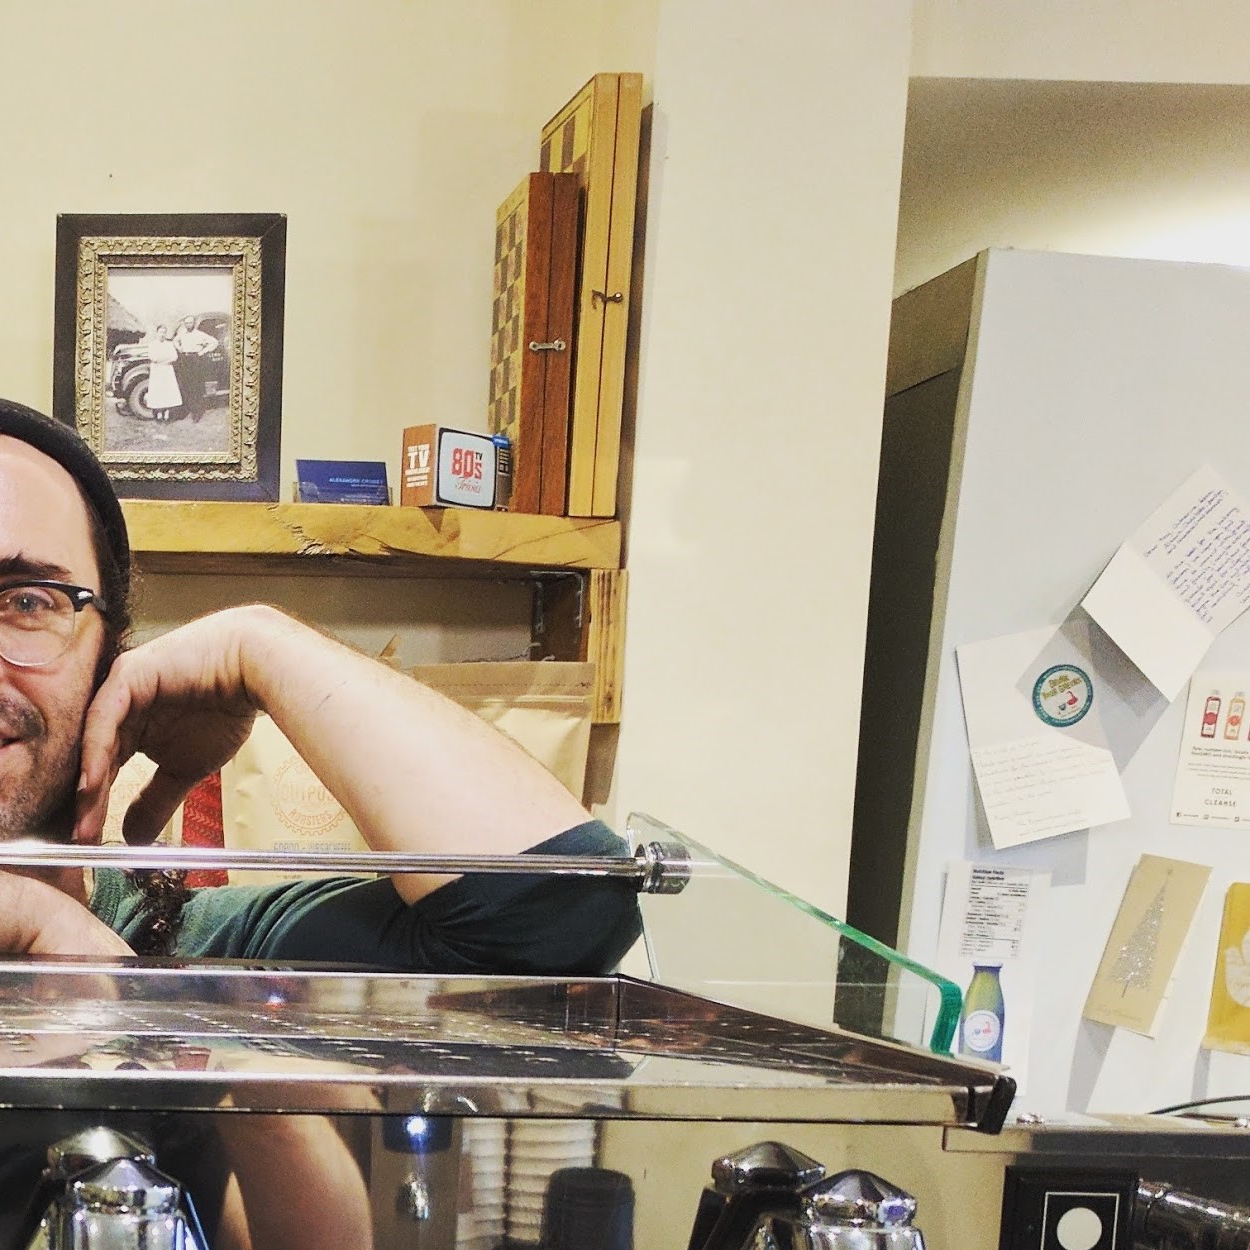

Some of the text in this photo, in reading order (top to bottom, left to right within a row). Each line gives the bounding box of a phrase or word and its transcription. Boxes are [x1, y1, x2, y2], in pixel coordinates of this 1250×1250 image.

[407, 451, 430, 469] TV
[475, 452, 483, 461] TV
[282, 783, 334, 802] OUTPO
[1212, 787, 1232, 796] TOTAL
[1204, 799, 1236, 808] CLEANSE
[290, 809, 332, 826] ROASTERS
